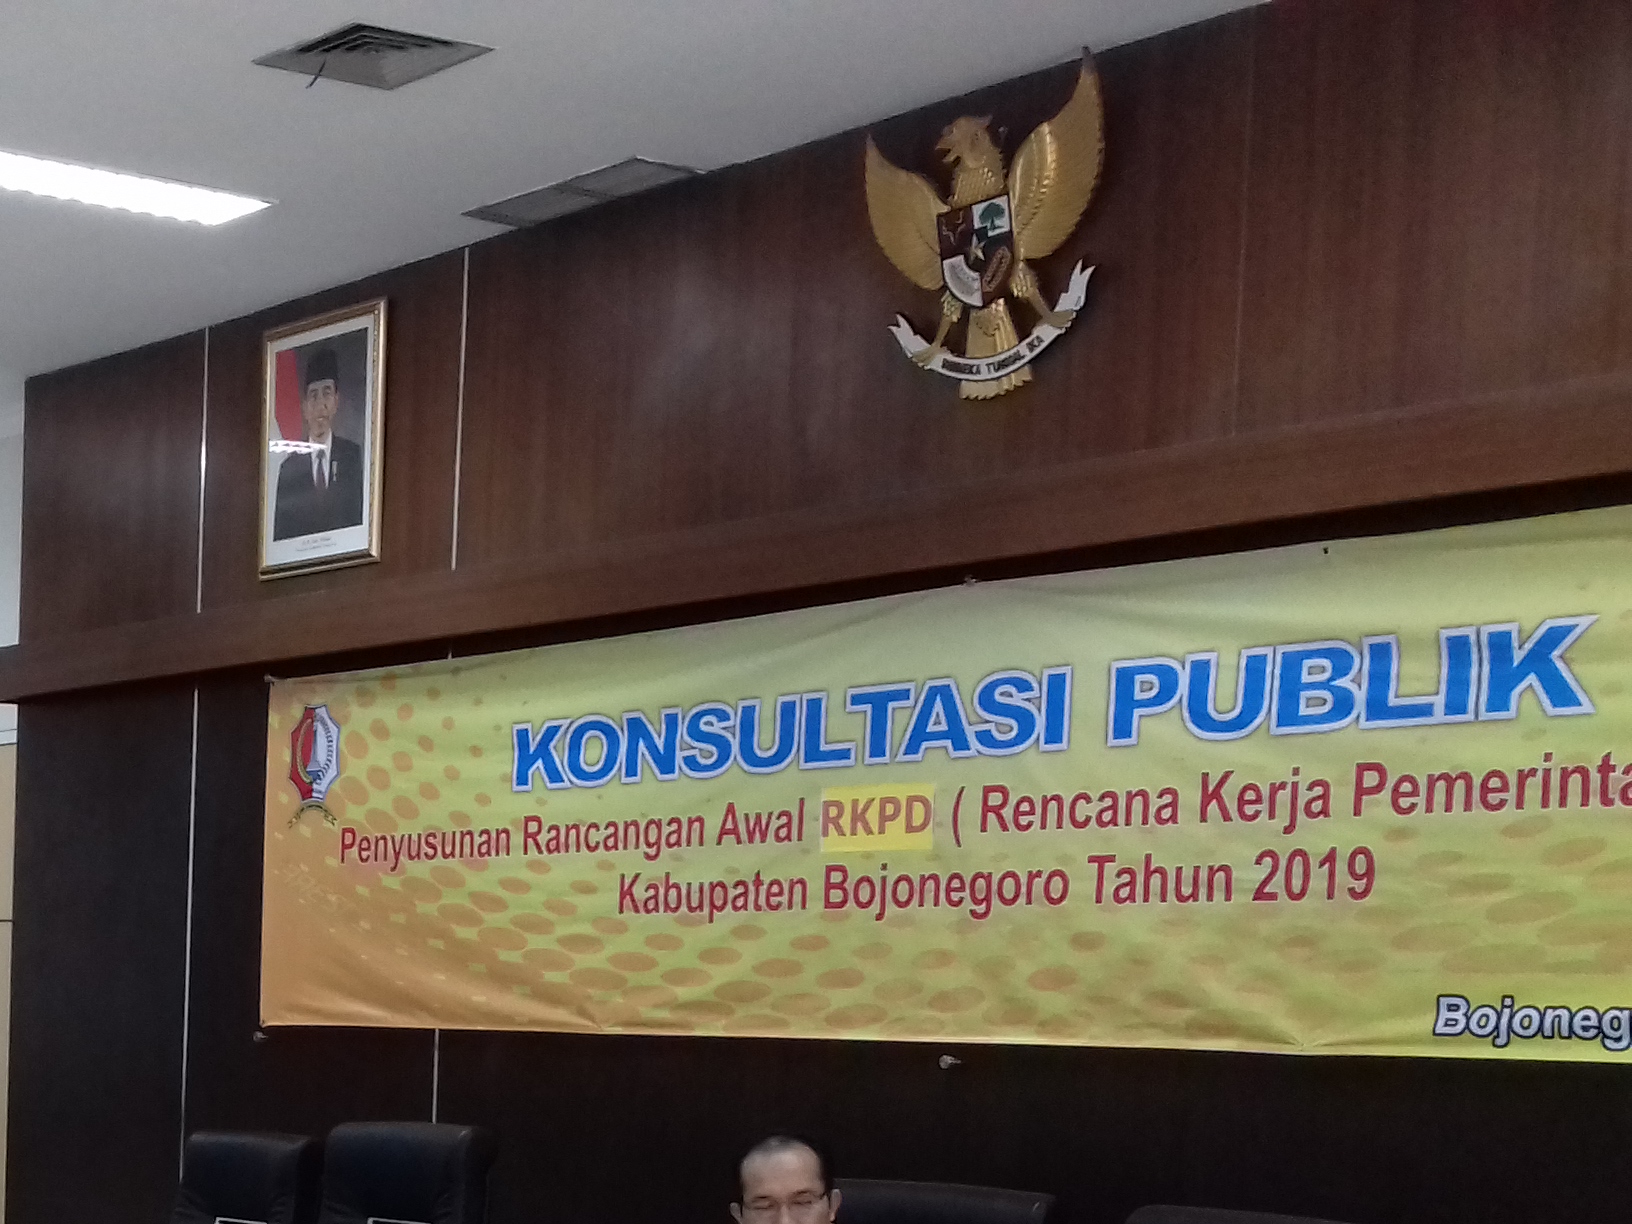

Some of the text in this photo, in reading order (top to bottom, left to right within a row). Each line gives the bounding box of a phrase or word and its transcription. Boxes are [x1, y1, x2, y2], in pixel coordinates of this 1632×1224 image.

[511, 613, 1601, 793] KONSULTASI PUBLIK
[339, 825, 512, 873] Penyusunan
[521, 812, 706, 862] Rancangan
[715, 797, 806, 847] Awal
[820, 793, 934, 839] RKPD
[950, 785, 967, 849] (
[979, 783, 1180, 835] Rencana
[1198, 766, 1333, 836] Kerja
[617, 845, 1378, 924] Kabupaten Bojonegoro Tahun 2019
[1433, 994, 1632, 1052] Bojoneg
